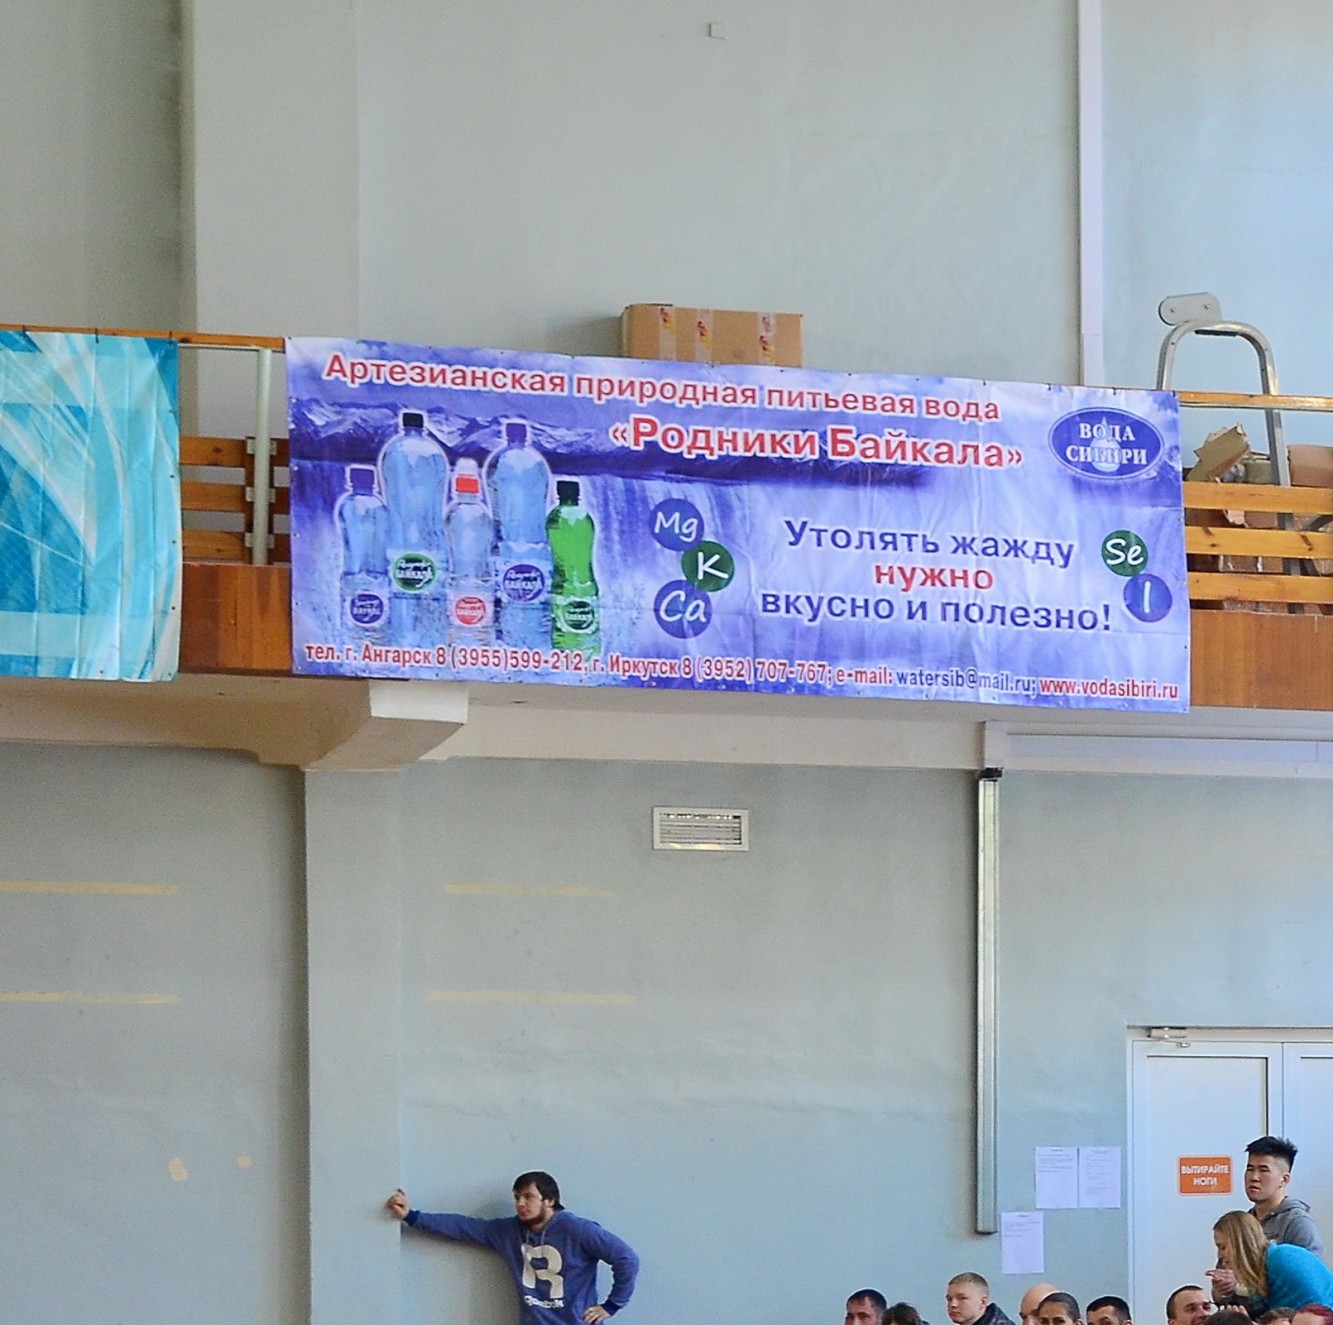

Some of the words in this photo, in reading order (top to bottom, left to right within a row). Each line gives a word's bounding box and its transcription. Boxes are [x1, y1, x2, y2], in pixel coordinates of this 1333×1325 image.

[326, 354, 565, 393] Артезианская
[576, 377, 756, 405] природная
[767, 389, 914, 414] питьевая
[925, 398, 999, 422] вода
[612, 417, 816, 457] «Родники
[831, 427, 1023, 467] Байкала»
[1079, 422, 1135, 442] ВОДА
[1065, 445, 1148, 465] СИБИРИ
[654, 511, 699, 542] Mg
[785, 520, 939, 553] Утолять
[950, 535, 1075, 569] жажду
[1106, 538, 1145, 565] Se
[697, 551, 729, 580] K
[875, 565, 994, 592] нужно
[659, 590, 707, 623] Ca
[762, 593, 894, 622] вкусно
[907, 601, 927, 621] и
[941, 602, 1110, 631] полезно!
[306, 644, 340, 661] тел.
[345, 648, 357, 662] г.
[362, 644, 432, 667] Ангарск
[436, 647, 446, 666] 8
[592, 657, 604, 672] г.
[609, 654, 679, 680] Иркутск
[681, 656, 692, 676] 8
[697, 656, 751, 682] (3952)
[836, 667, 892, 685] e-mail:
[1039, 678, 1178, 699] www.vodasibiri.ru
